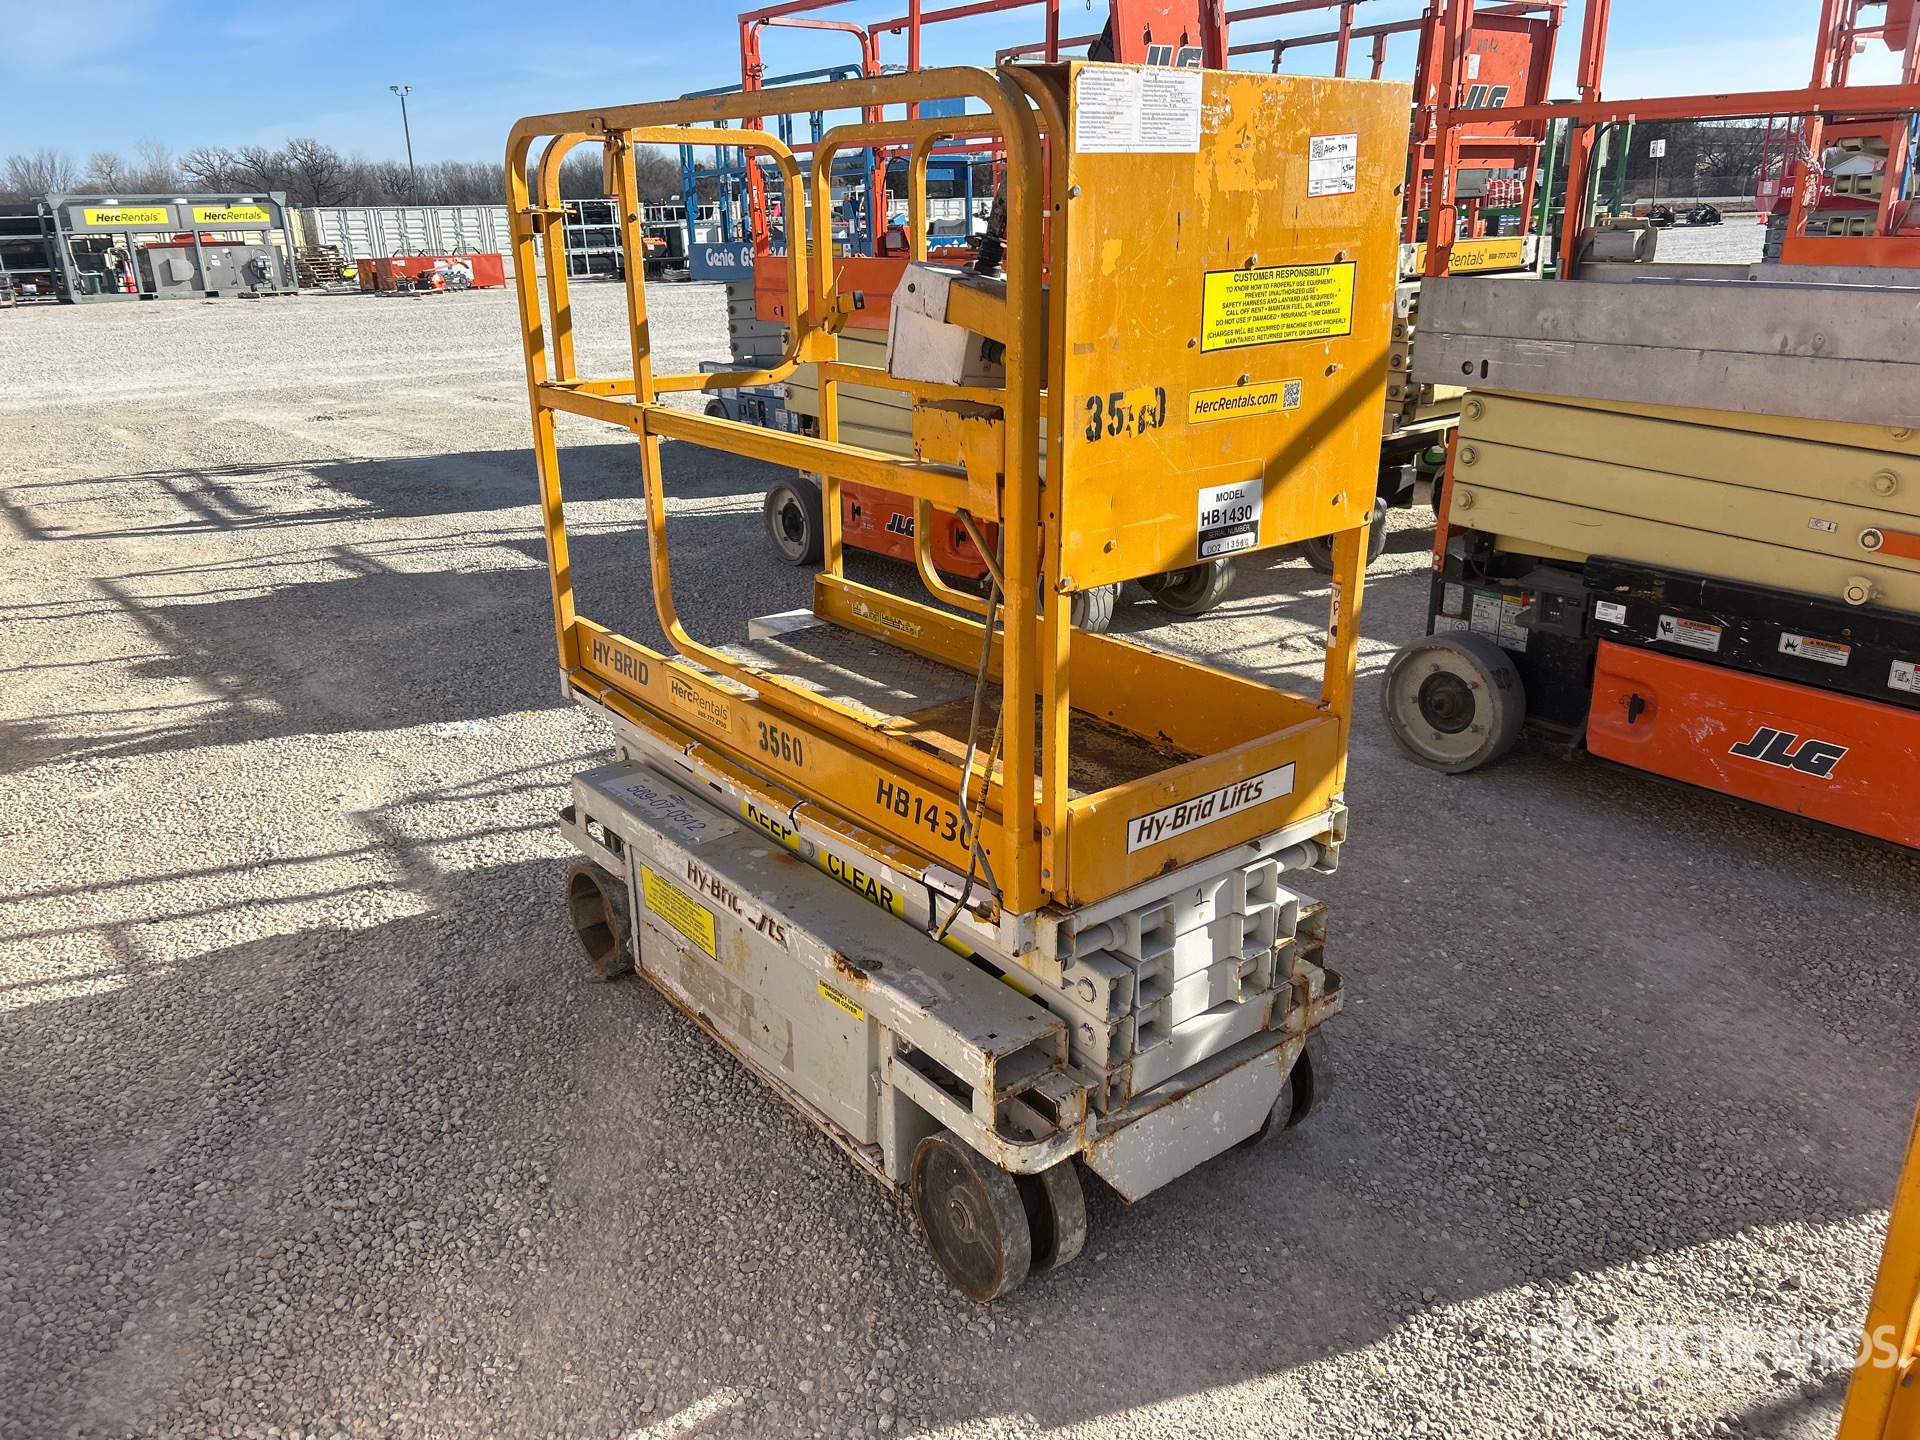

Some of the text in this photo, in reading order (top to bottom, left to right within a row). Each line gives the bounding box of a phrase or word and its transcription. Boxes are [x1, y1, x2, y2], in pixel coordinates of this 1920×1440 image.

[96, 213, 158, 222] HercRentals
[204, 211, 261, 221] HercRentals
[705, 247, 735, 267] Genie
[1233, 267, 1331, 283] CUSTOMER RESPONSIBILITY
[1251, 283, 1262, 291] HOW
[1307, 278, 1333, 286] EQUIPMENT
[1245, 291, 1267, 299] PREVENT
[1269, 288, 1305, 297] UNAUTHORIZED
[1222, 301, 1241, 309] SAFETY
[1242, 299, 1266, 307] HARNESS
[1268, 304, 1290, 312] MAINTAIN
[1253, 314, 1277, 322] DAMAGED
[1281, 311, 1307, 319] INSURANCE
[1235, 327, 1246, 335] WILL
[1255, 324, 1280, 332] INCURRED
[1324, 318, 1346, 326] PROPERLY
[1257, 332, 1283, 341] RETURNED
[1194, 391, 1278, 414] HercRentals.com
[1215, 489, 1245, 503] MODEL
[1201, 505, 1252, 527] HB1430
[1208, 524, 1251, 539] SERIAL NUMBER
[1689, 622, 1711, 631] WARNING
[1815, 641, 1841, 650] WARNING
[592, 638, 649, 686] HY-BRID
[671, 680, 728, 720] HercRentals
[697, 709, 727, 730] 888-777-2700
[758, 720, 803, 768] 3560
[1727, 726, 1850, 779] JLG
[1136, 794, 1216, 844] Hy-Brid
[1219, 780, 1265, 813] Lifts
[826, 852, 895, 915] CLEAR
[1194, 887, 1210, 908] 1
[825, 990, 858, 1015] UNDER COVER
